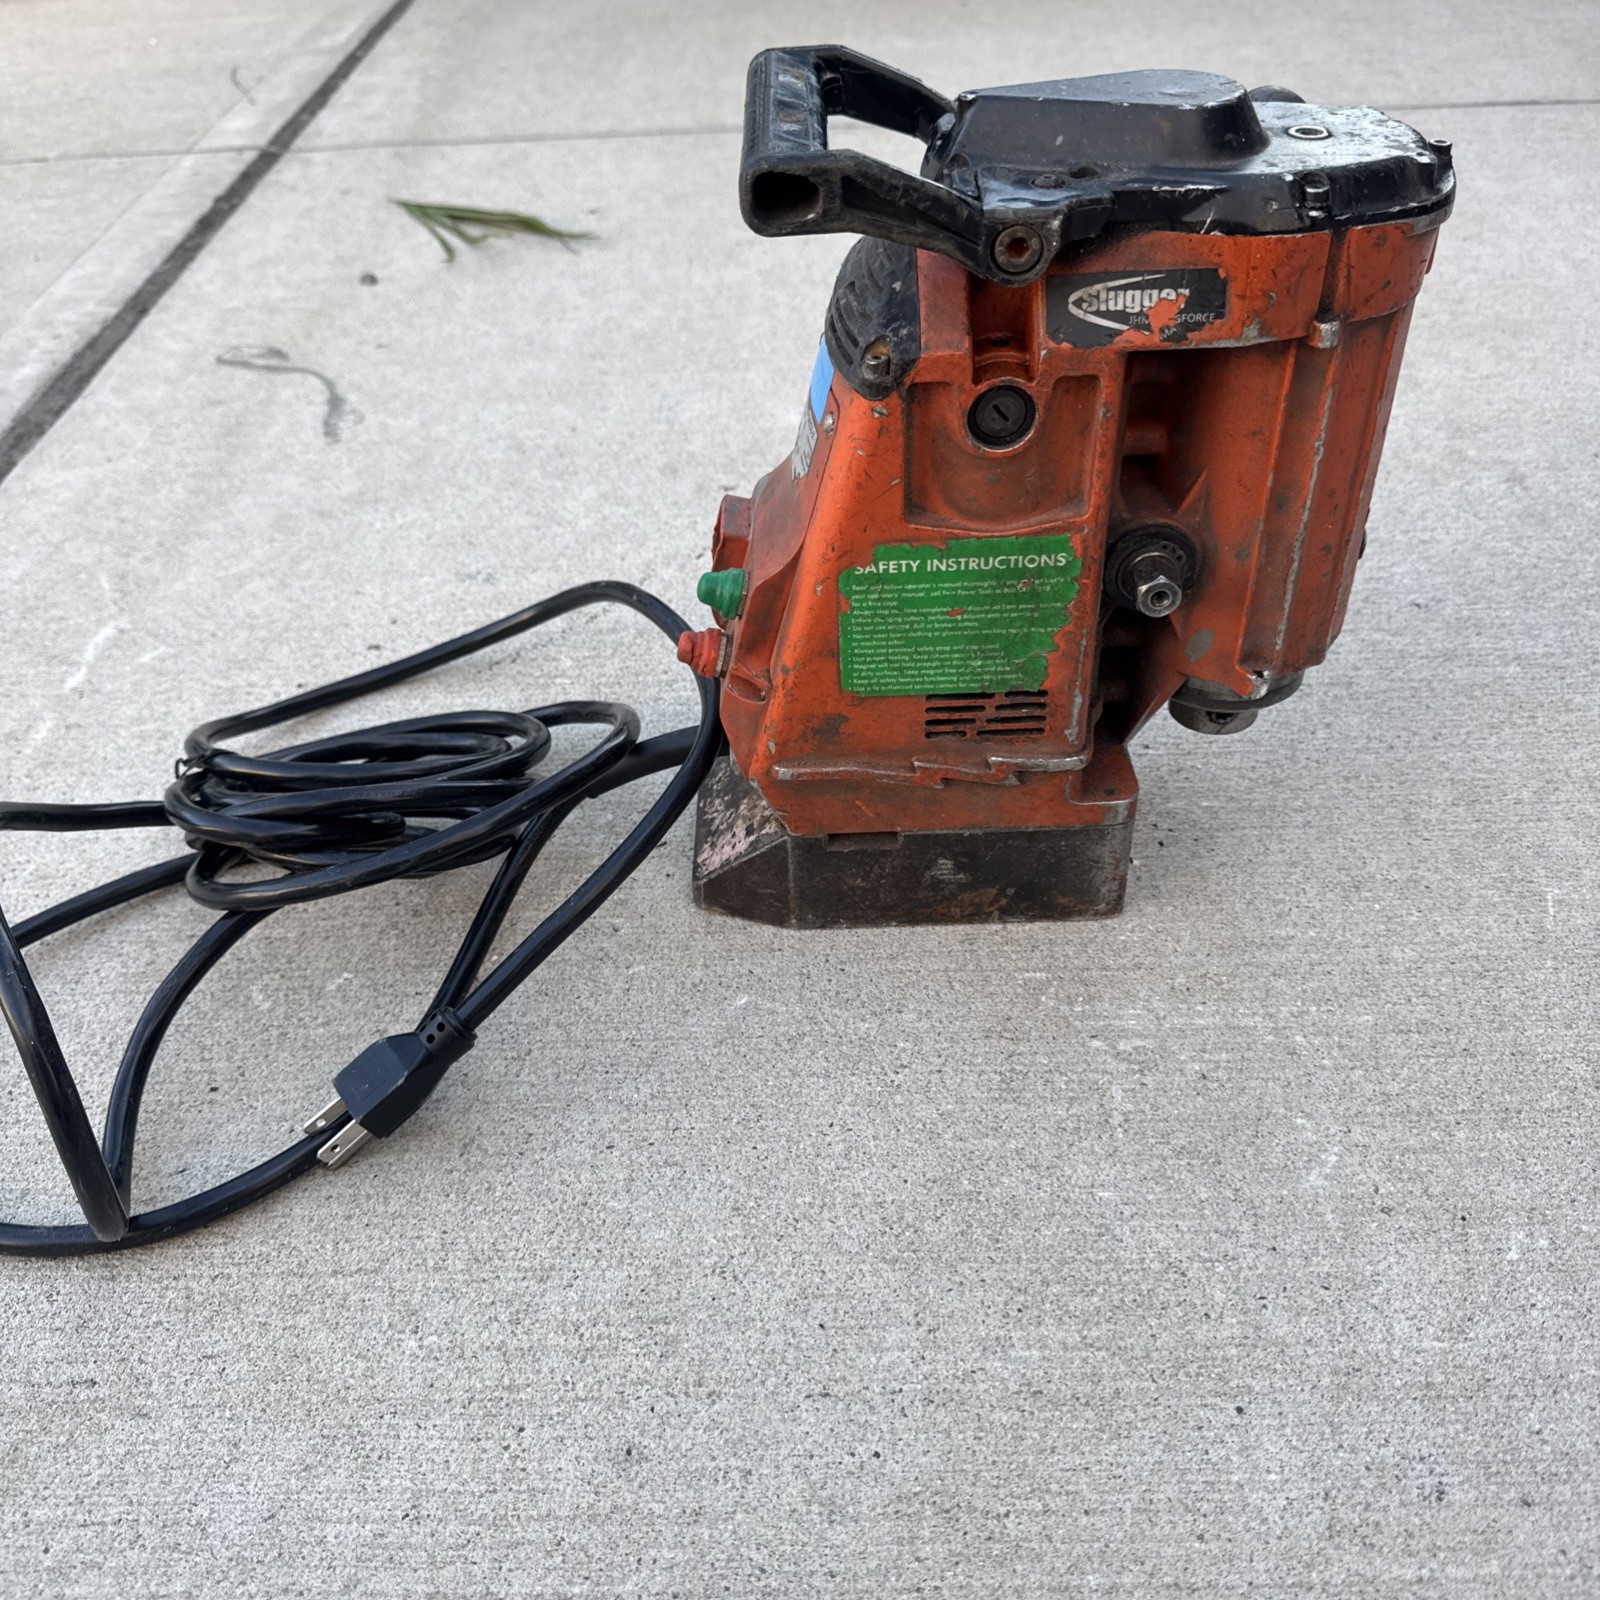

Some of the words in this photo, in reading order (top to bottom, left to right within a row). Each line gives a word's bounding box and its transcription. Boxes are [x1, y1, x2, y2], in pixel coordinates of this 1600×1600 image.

[1176, 312, 1216, 323] GFORCE
[854, 560, 920, 574] SAFETY
[926, 553, 1068, 572] INSTRUCTIONS
